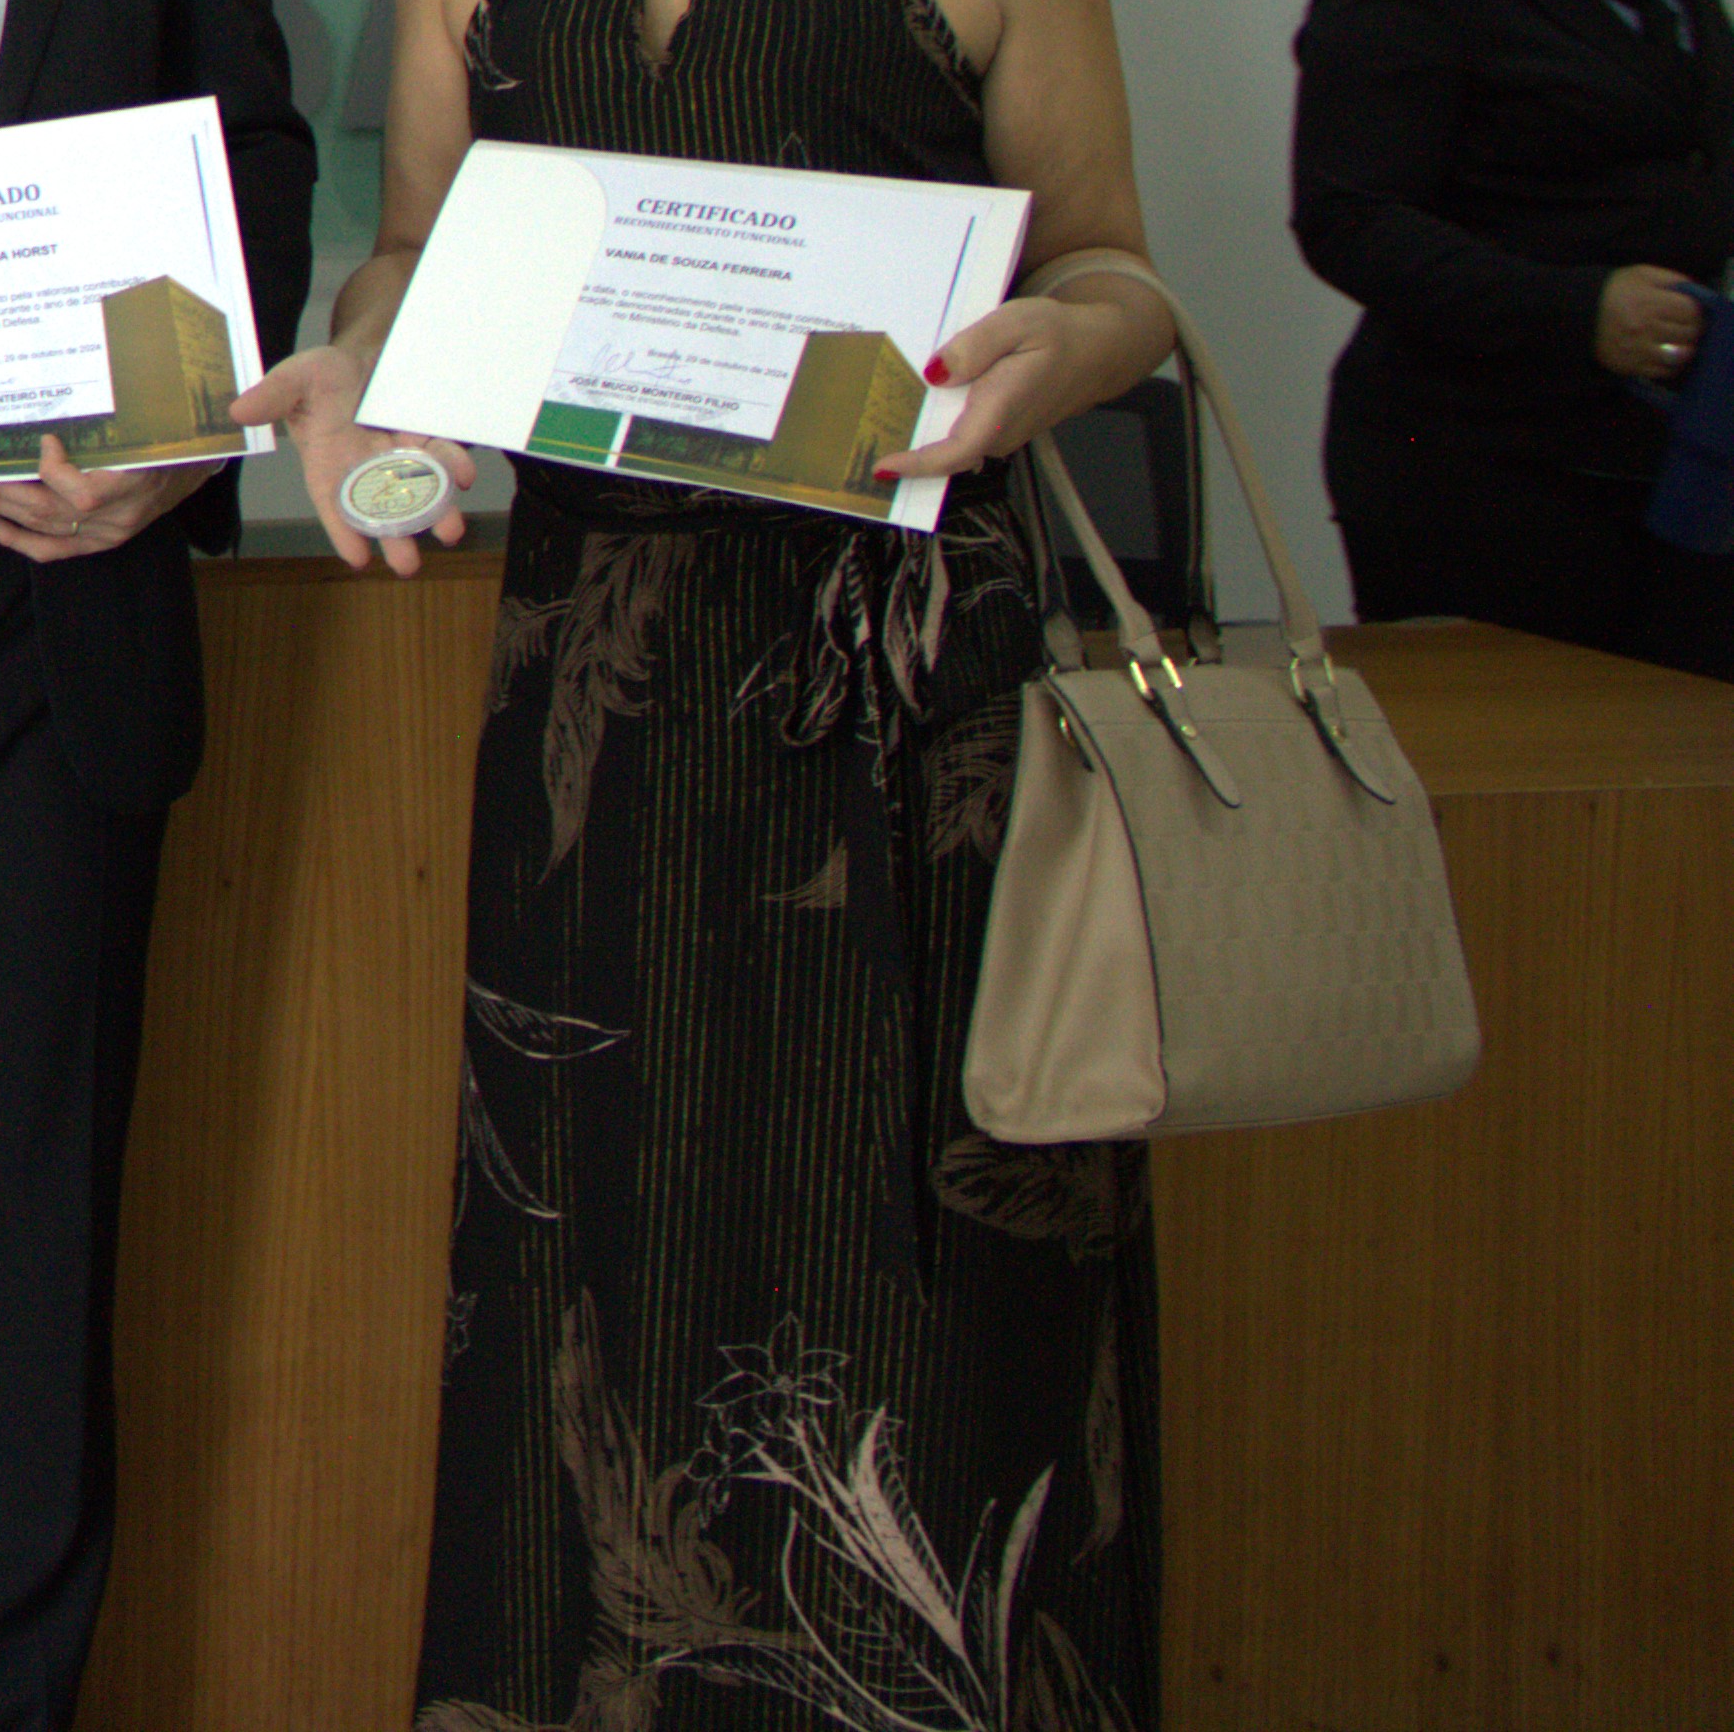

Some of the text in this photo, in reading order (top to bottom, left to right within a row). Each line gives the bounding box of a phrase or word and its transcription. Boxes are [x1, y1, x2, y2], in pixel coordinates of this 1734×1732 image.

[636, 198, 797, 231] CERTIFICADO
[613, 216, 807, 248] RECONHECIMENTO FUNCIONAL
[12, 244, 58, 259] HORST
[605, 248, 792, 281] VANIA DE SOUZA FERREIRA
[40, 386, 73, 399] FILHO
[569, 376, 740, 411] JOSÉ MUCIO MONTEIRO FILHO
